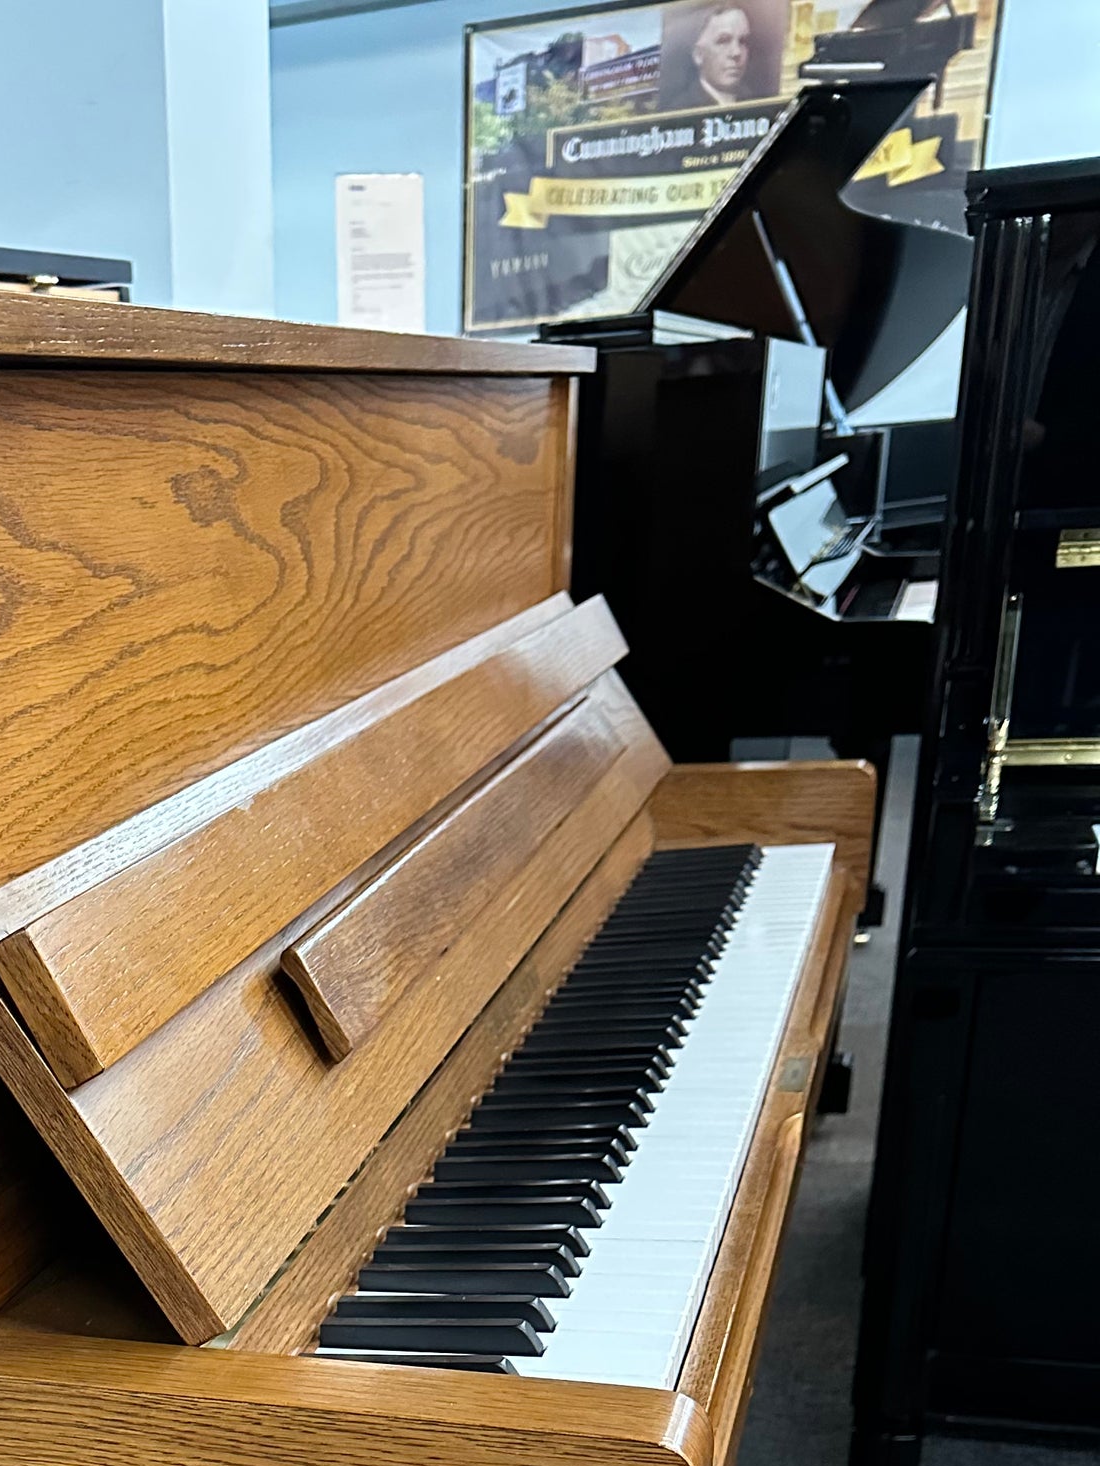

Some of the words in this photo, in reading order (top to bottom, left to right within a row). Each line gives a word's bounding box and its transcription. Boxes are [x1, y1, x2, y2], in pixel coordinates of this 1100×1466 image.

[562, 126, 695, 162] Cunningham
[700, 114, 770, 148] Piano
[546, 185, 659, 206] CELEBRATING
[666, 180, 704, 201] OUR
